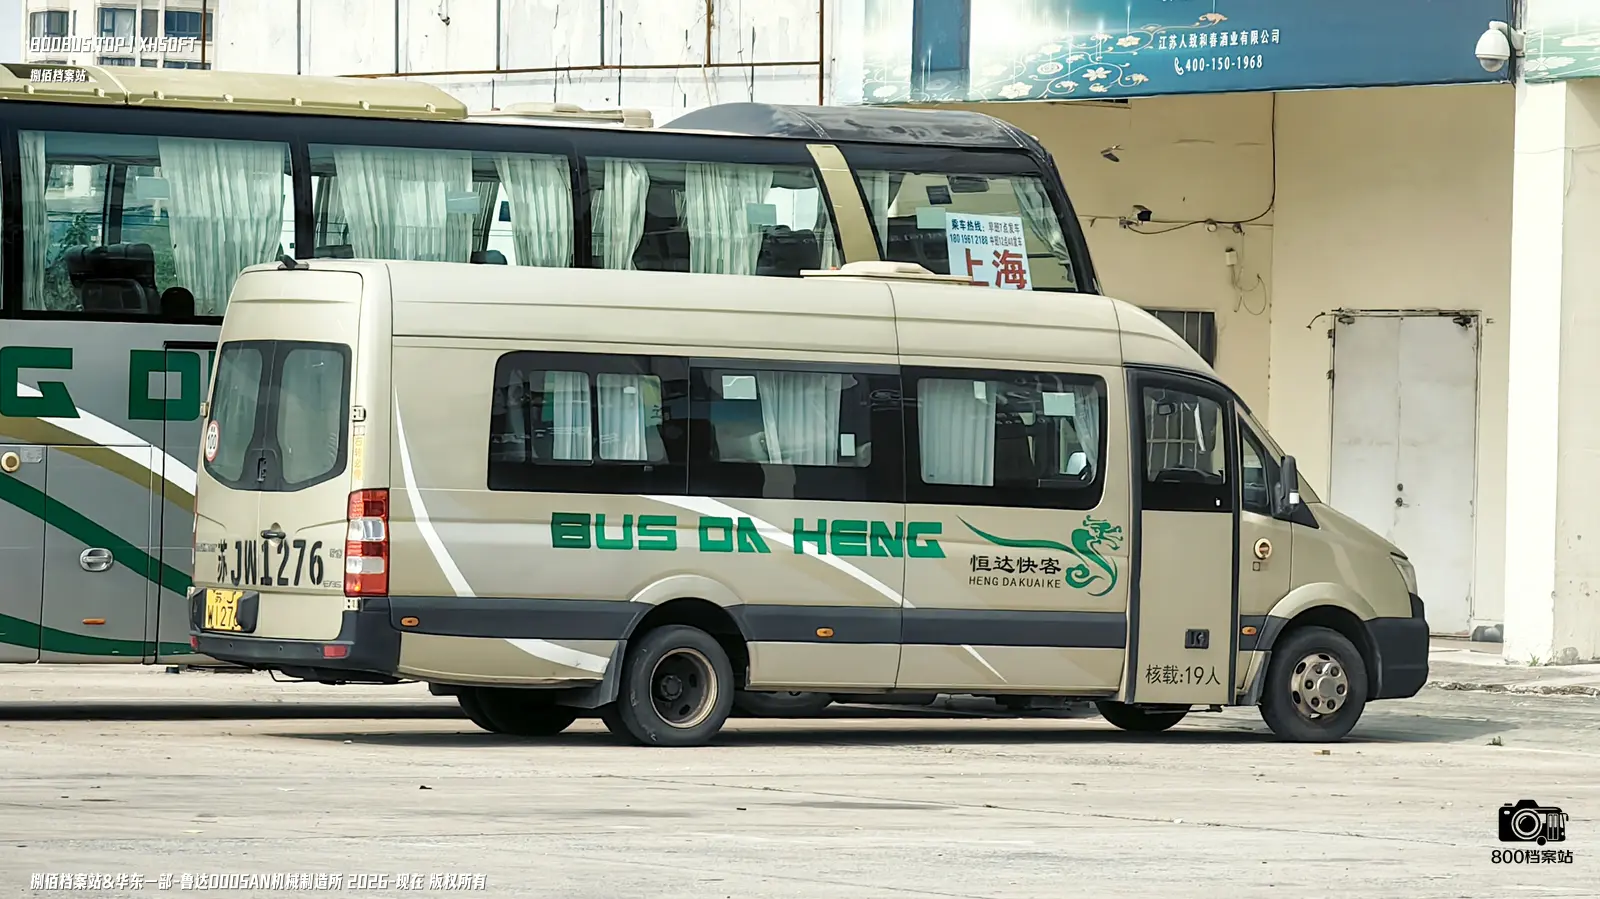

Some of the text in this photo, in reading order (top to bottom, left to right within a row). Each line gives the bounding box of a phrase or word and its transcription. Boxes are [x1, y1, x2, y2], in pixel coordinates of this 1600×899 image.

[1158, 29, 1280, 50] 江苏人致和春酒业有限公司
[1185, 54, 1264, 72] 400-150-1968
[965, 248, 1027, 290] 上海
[551, 512, 678, 552] BUS
[793, 518, 947, 559] HENG
[969, 554, 1062, 575] 恒达快客
